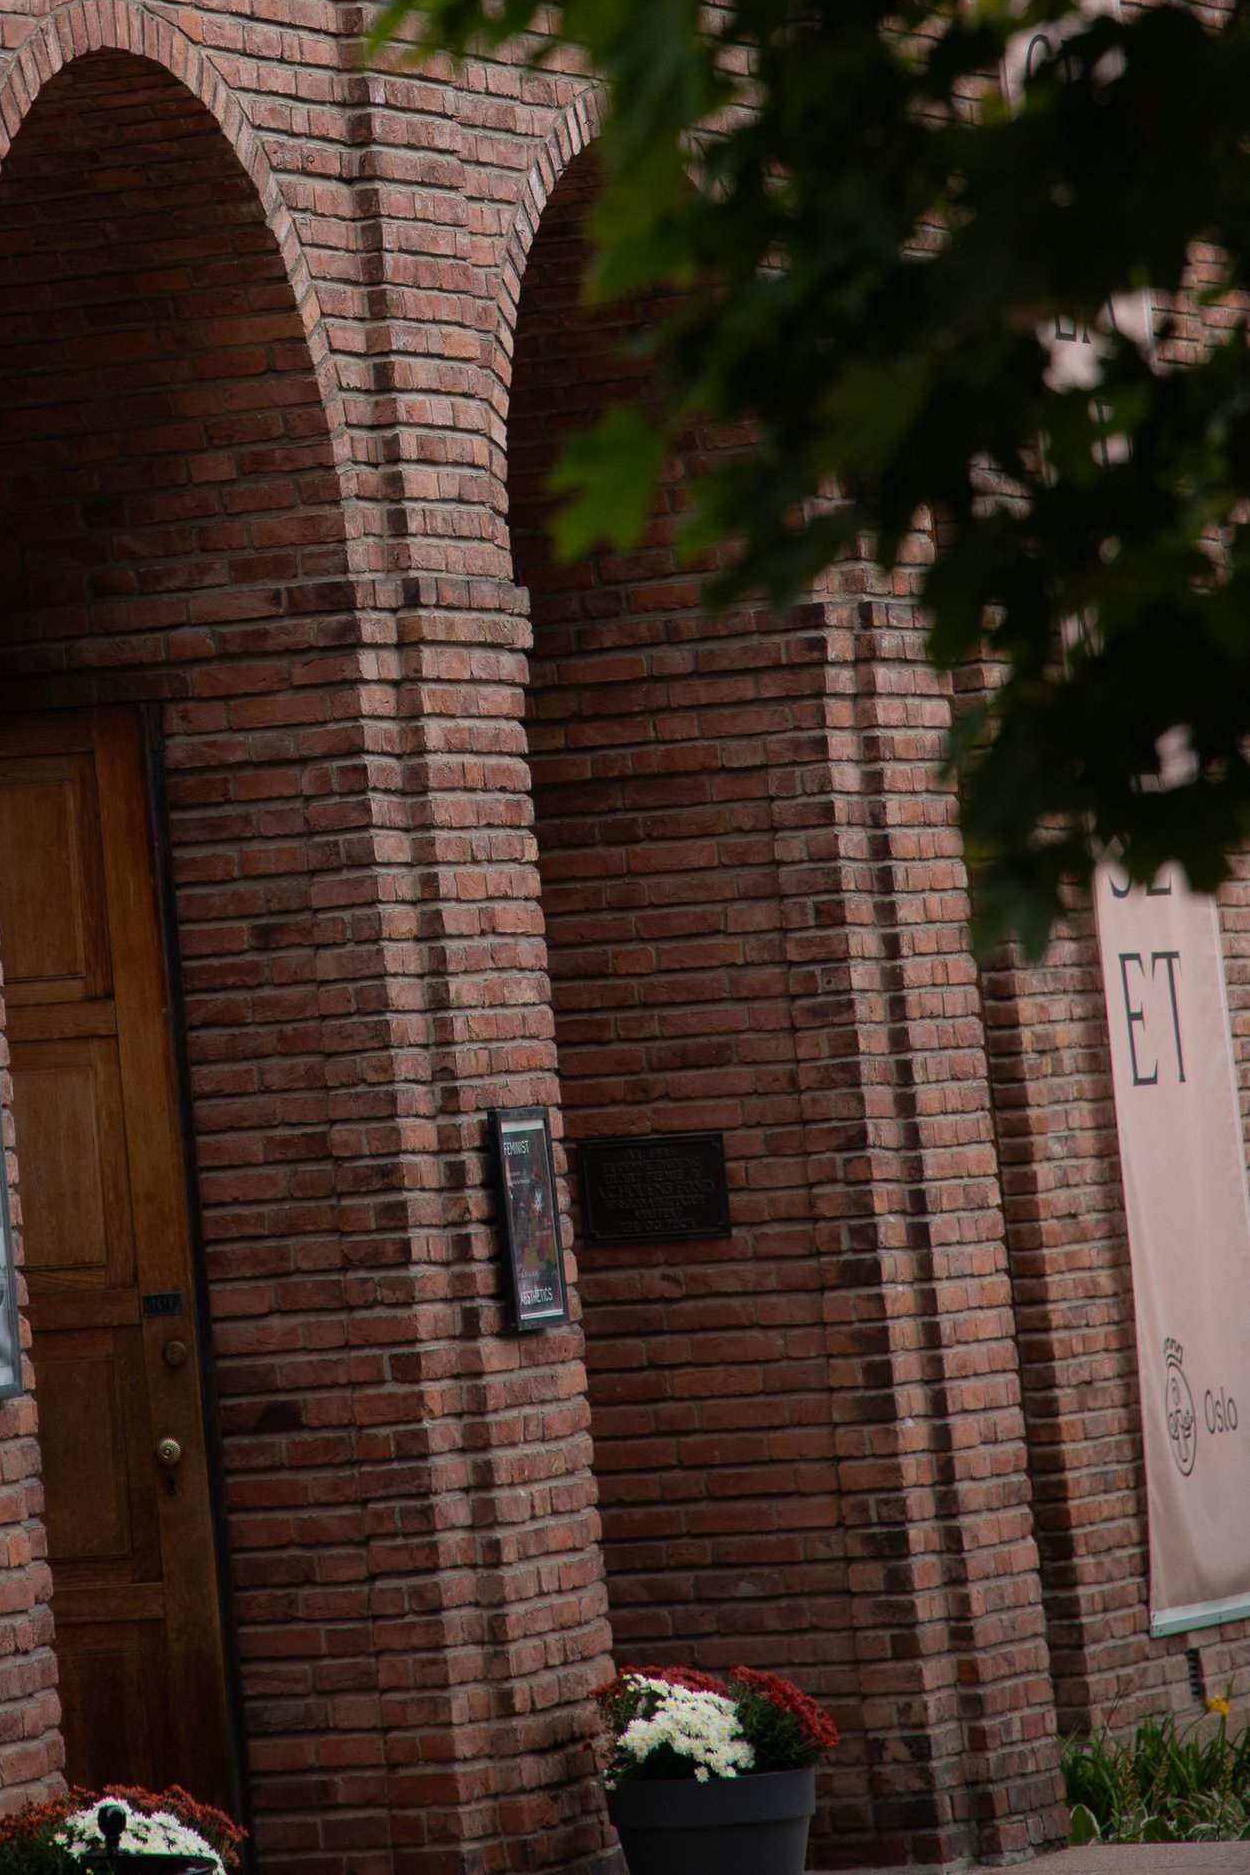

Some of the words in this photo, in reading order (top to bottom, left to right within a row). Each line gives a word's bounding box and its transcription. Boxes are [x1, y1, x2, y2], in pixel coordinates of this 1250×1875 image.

[1118, 951, 1186, 1086] ET
[503, 1140, 530, 1156] FEMINIST
[520, 1287, 553, 1306] AESTHETICS
[1204, 1387, 1238, 1435] Oslo
